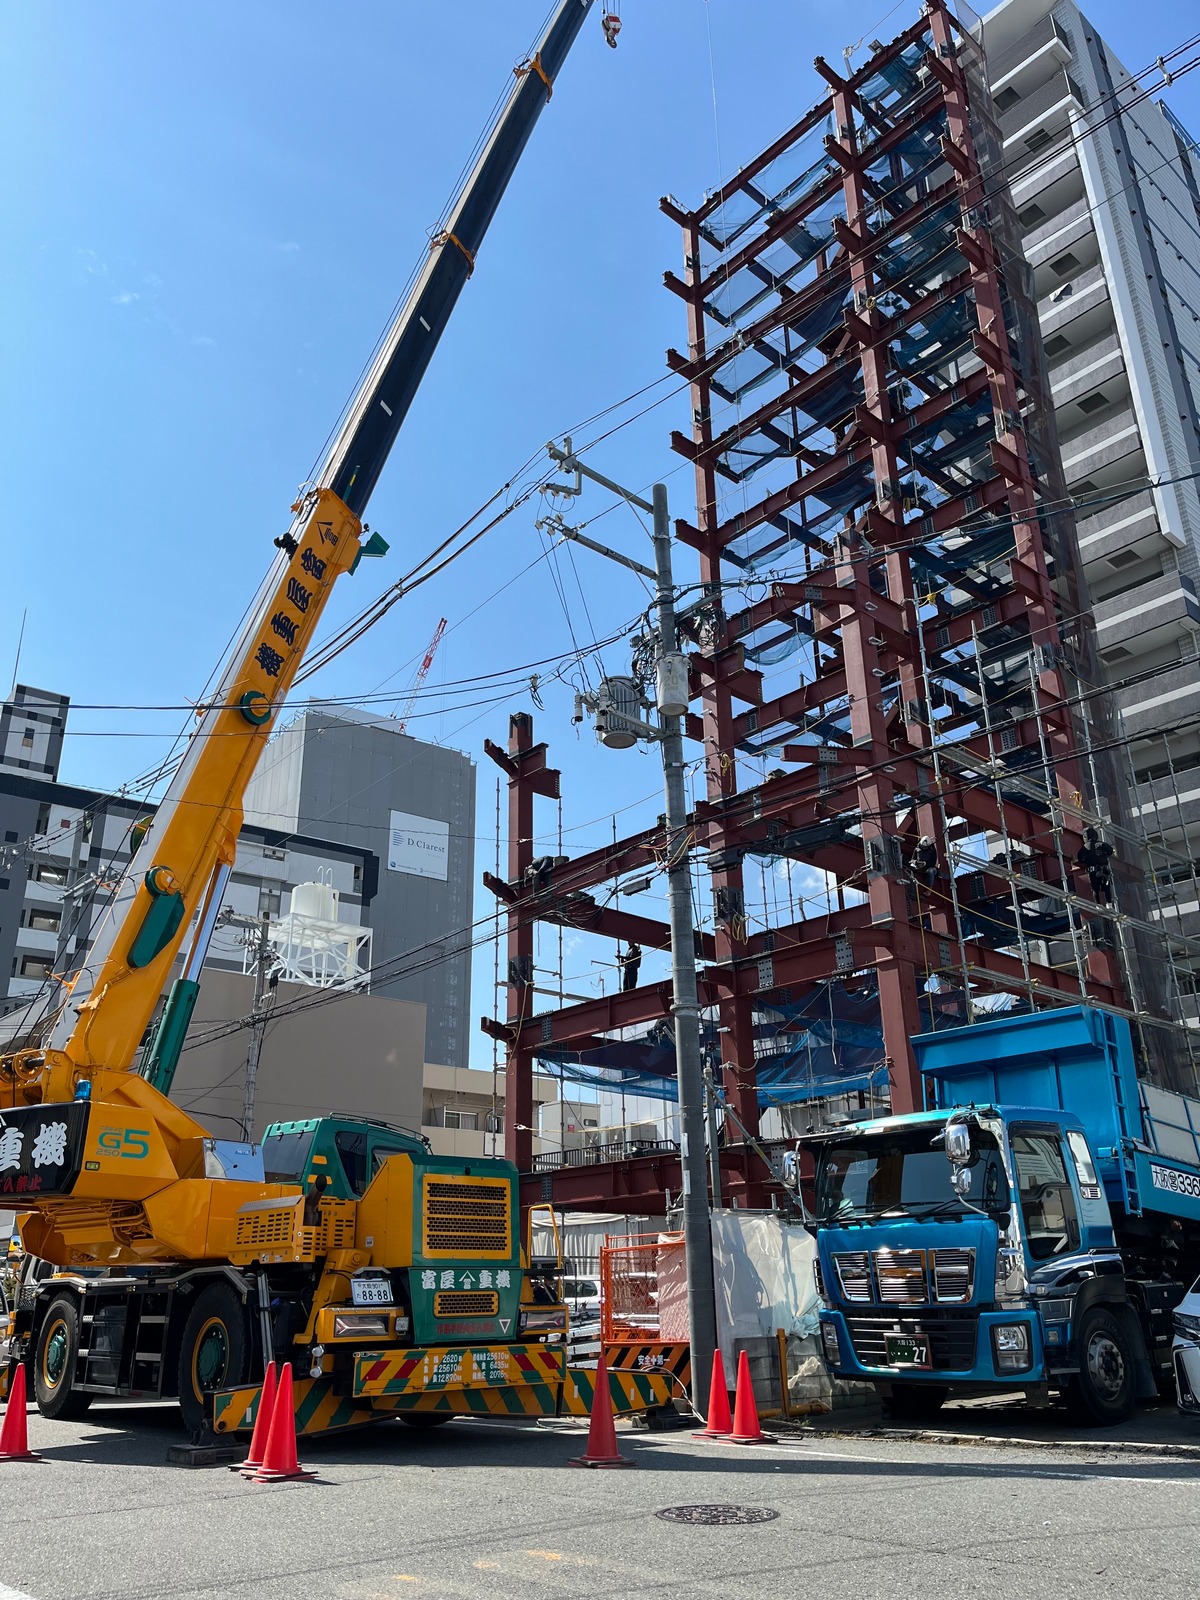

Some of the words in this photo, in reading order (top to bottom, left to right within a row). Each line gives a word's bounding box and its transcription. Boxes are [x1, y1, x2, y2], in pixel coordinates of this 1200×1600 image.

[407, 838, 445, 853] D.Clarest
[98, 1128, 150, 1159] G5
[362, 1290, 388, 1301] 88-88
